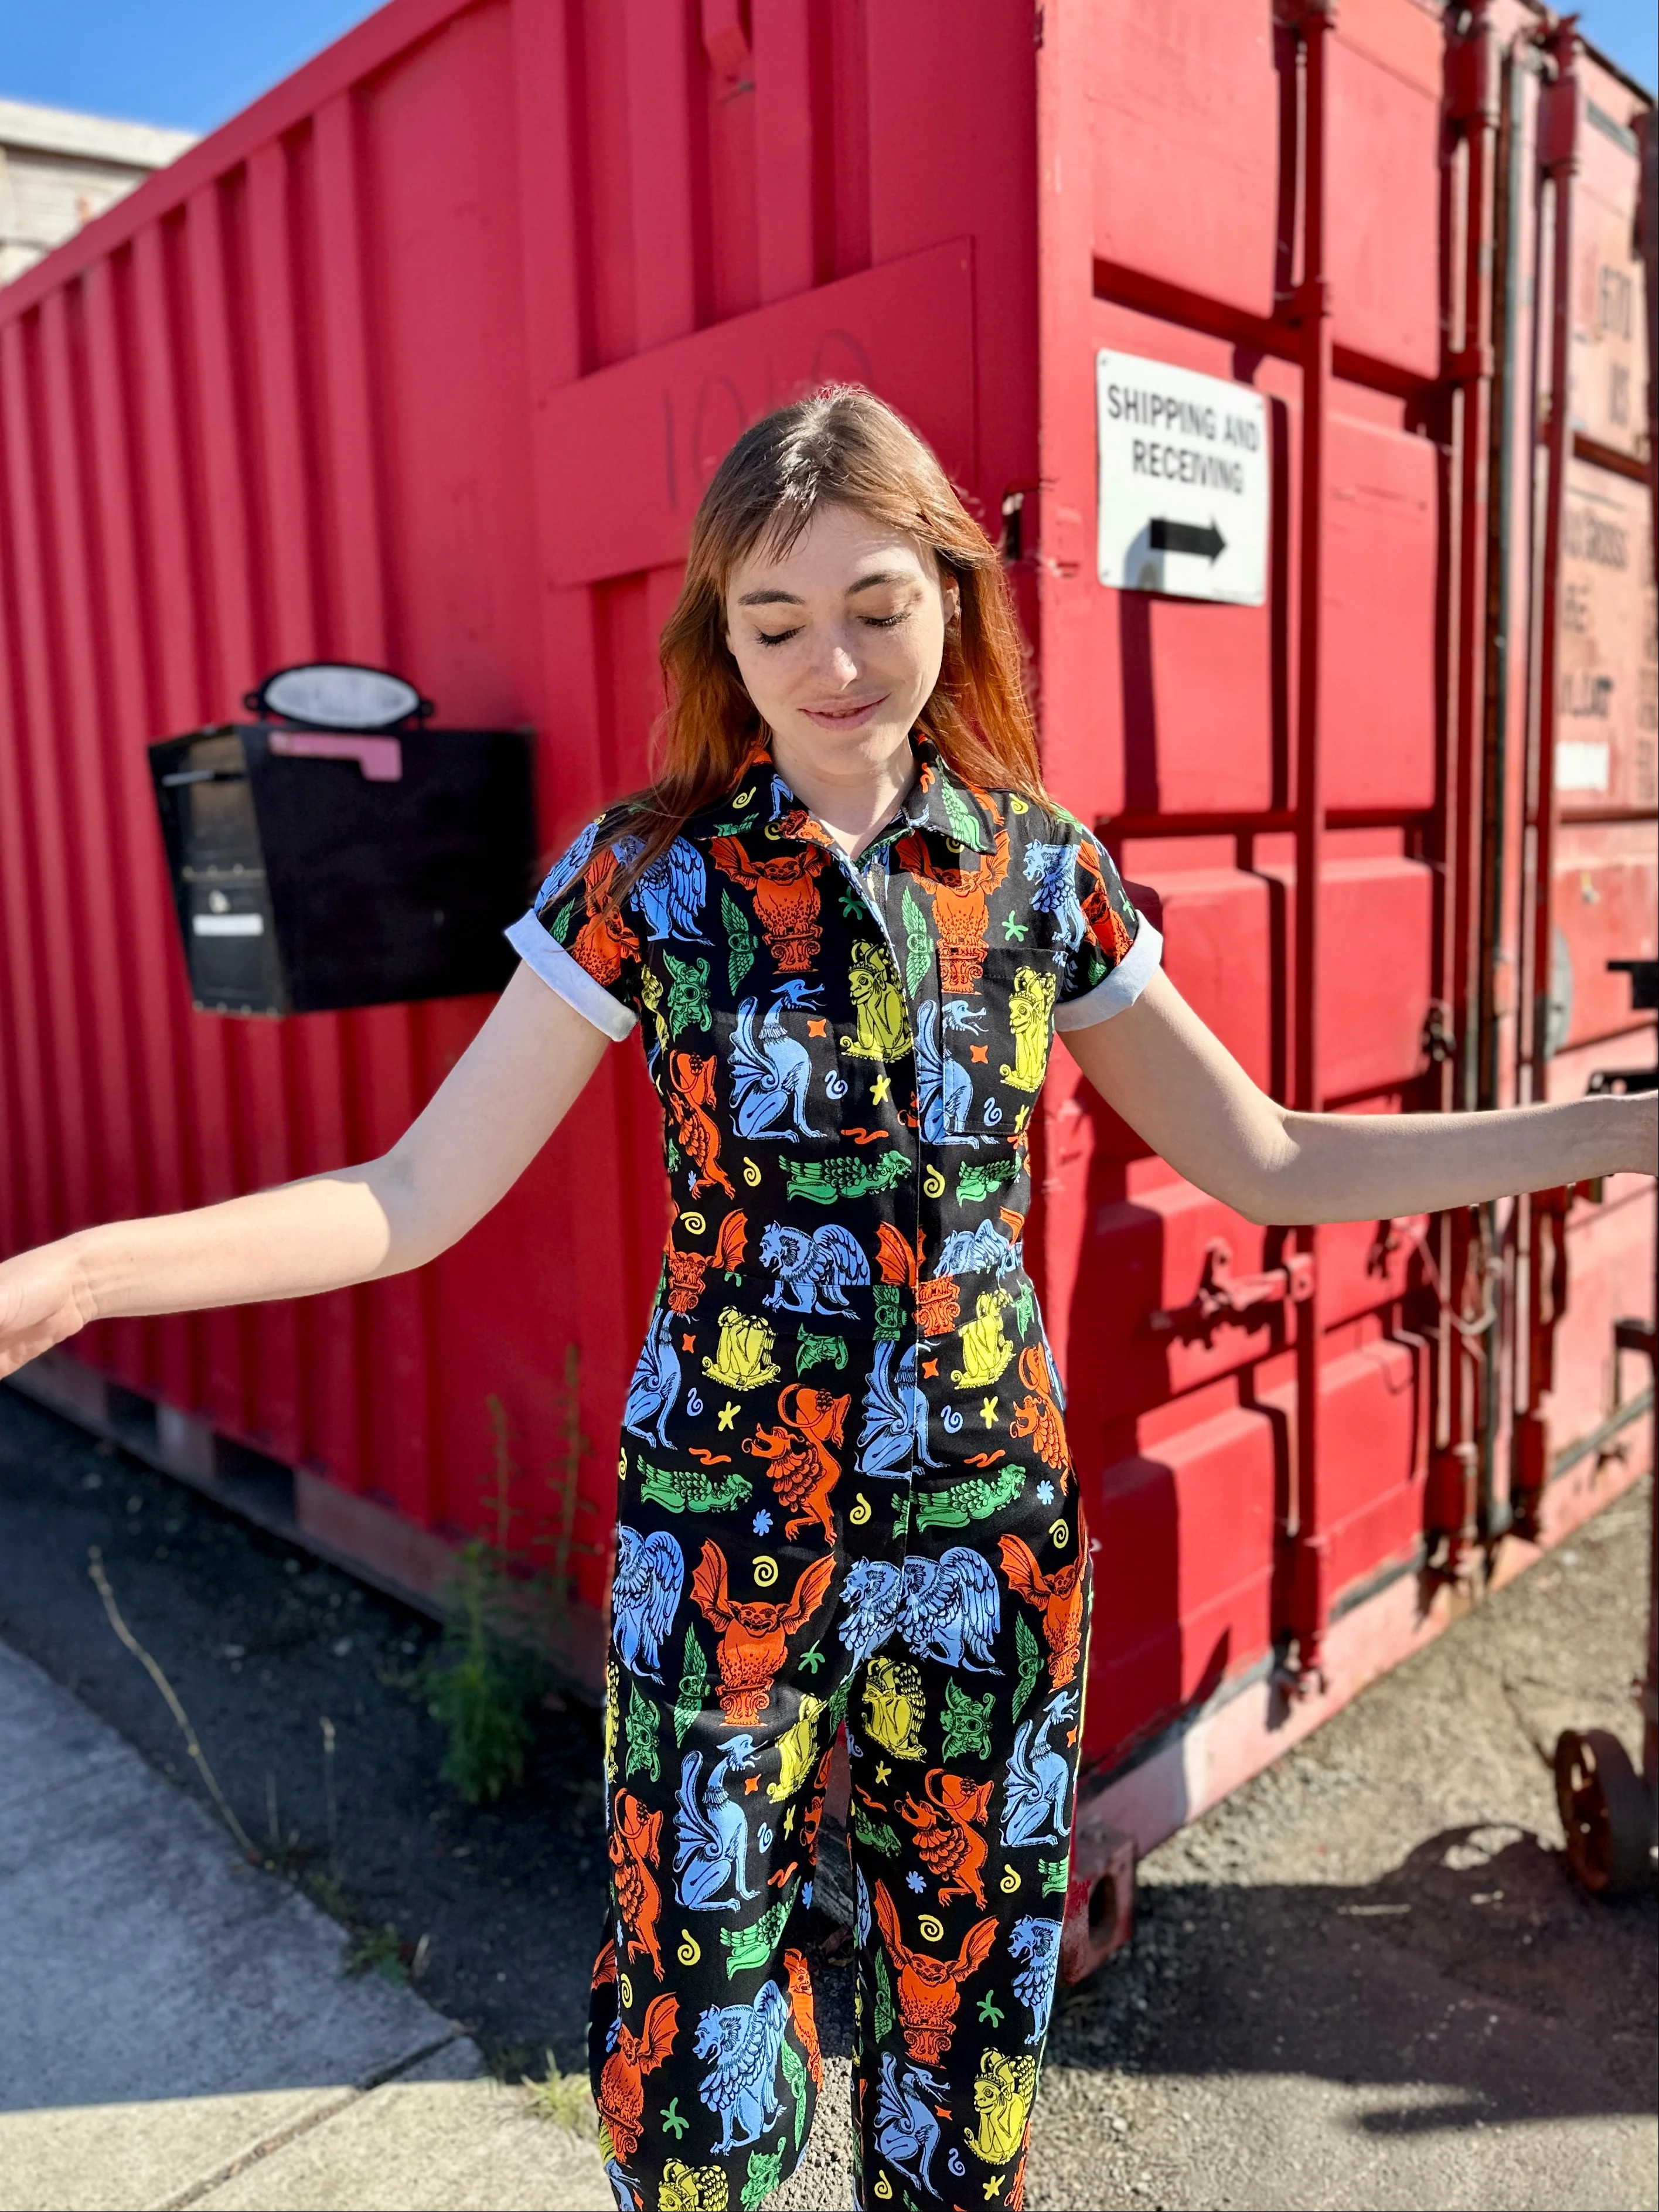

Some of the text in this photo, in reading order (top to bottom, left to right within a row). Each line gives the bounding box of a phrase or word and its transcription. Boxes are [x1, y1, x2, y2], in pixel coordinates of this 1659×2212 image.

[1108, 384, 1259, 452] SHIPPING AND
[1132, 440, 1243, 494] RECEIVING
